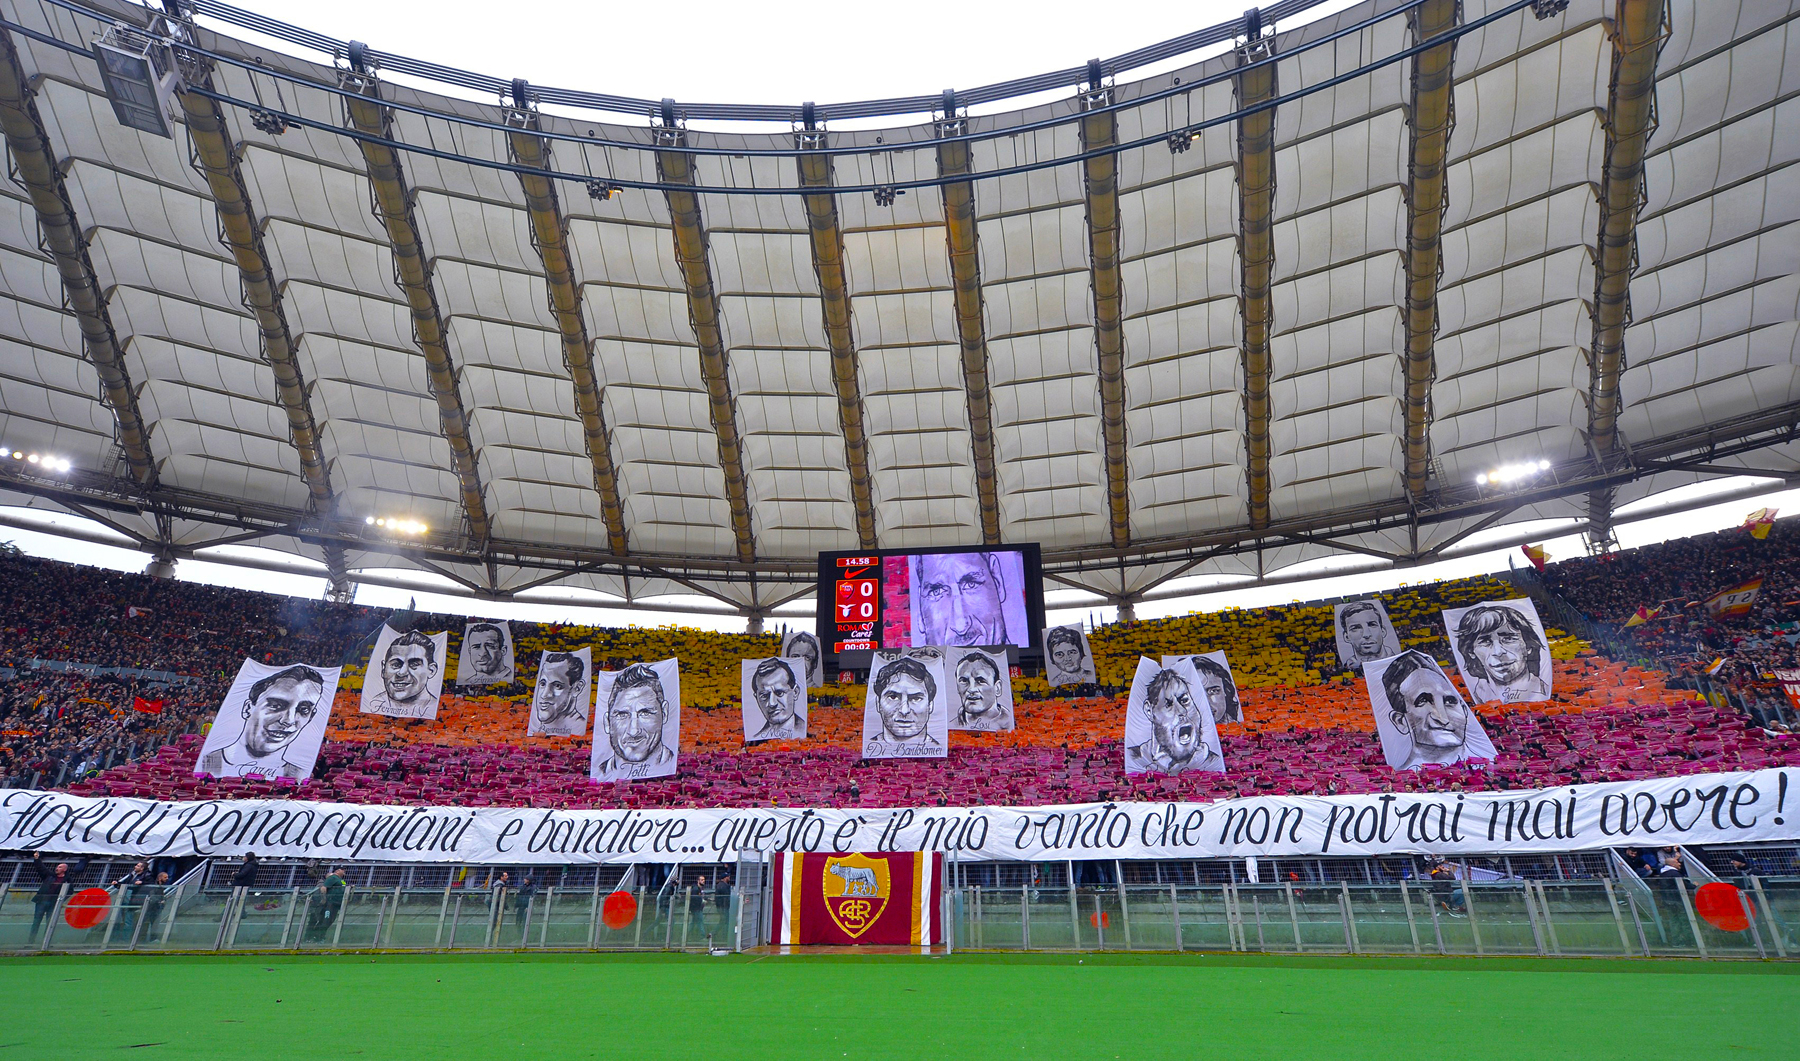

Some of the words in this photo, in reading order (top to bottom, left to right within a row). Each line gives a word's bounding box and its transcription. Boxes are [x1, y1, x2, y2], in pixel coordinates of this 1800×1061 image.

[846, 557, 870, 566] 14.58
[861, 582, 873, 597] 0
[861, 602, 873, 617] 0
[837, 624, 863, 632] ROMA
[620, 761, 650, 779] Totti
[106, 804, 173, 846] di
[496, 815, 523, 852] e
[877, 809, 913, 852] il
[920, 811, 989, 851] mio
[1015, 803, 1131, 850] vanto
[1142, 803, 1204, 847] che
[1220, 806, 1303, 845] non
[1322, 795, 1465, 853] potrai
[1485, 788, 1580, 842] mai
